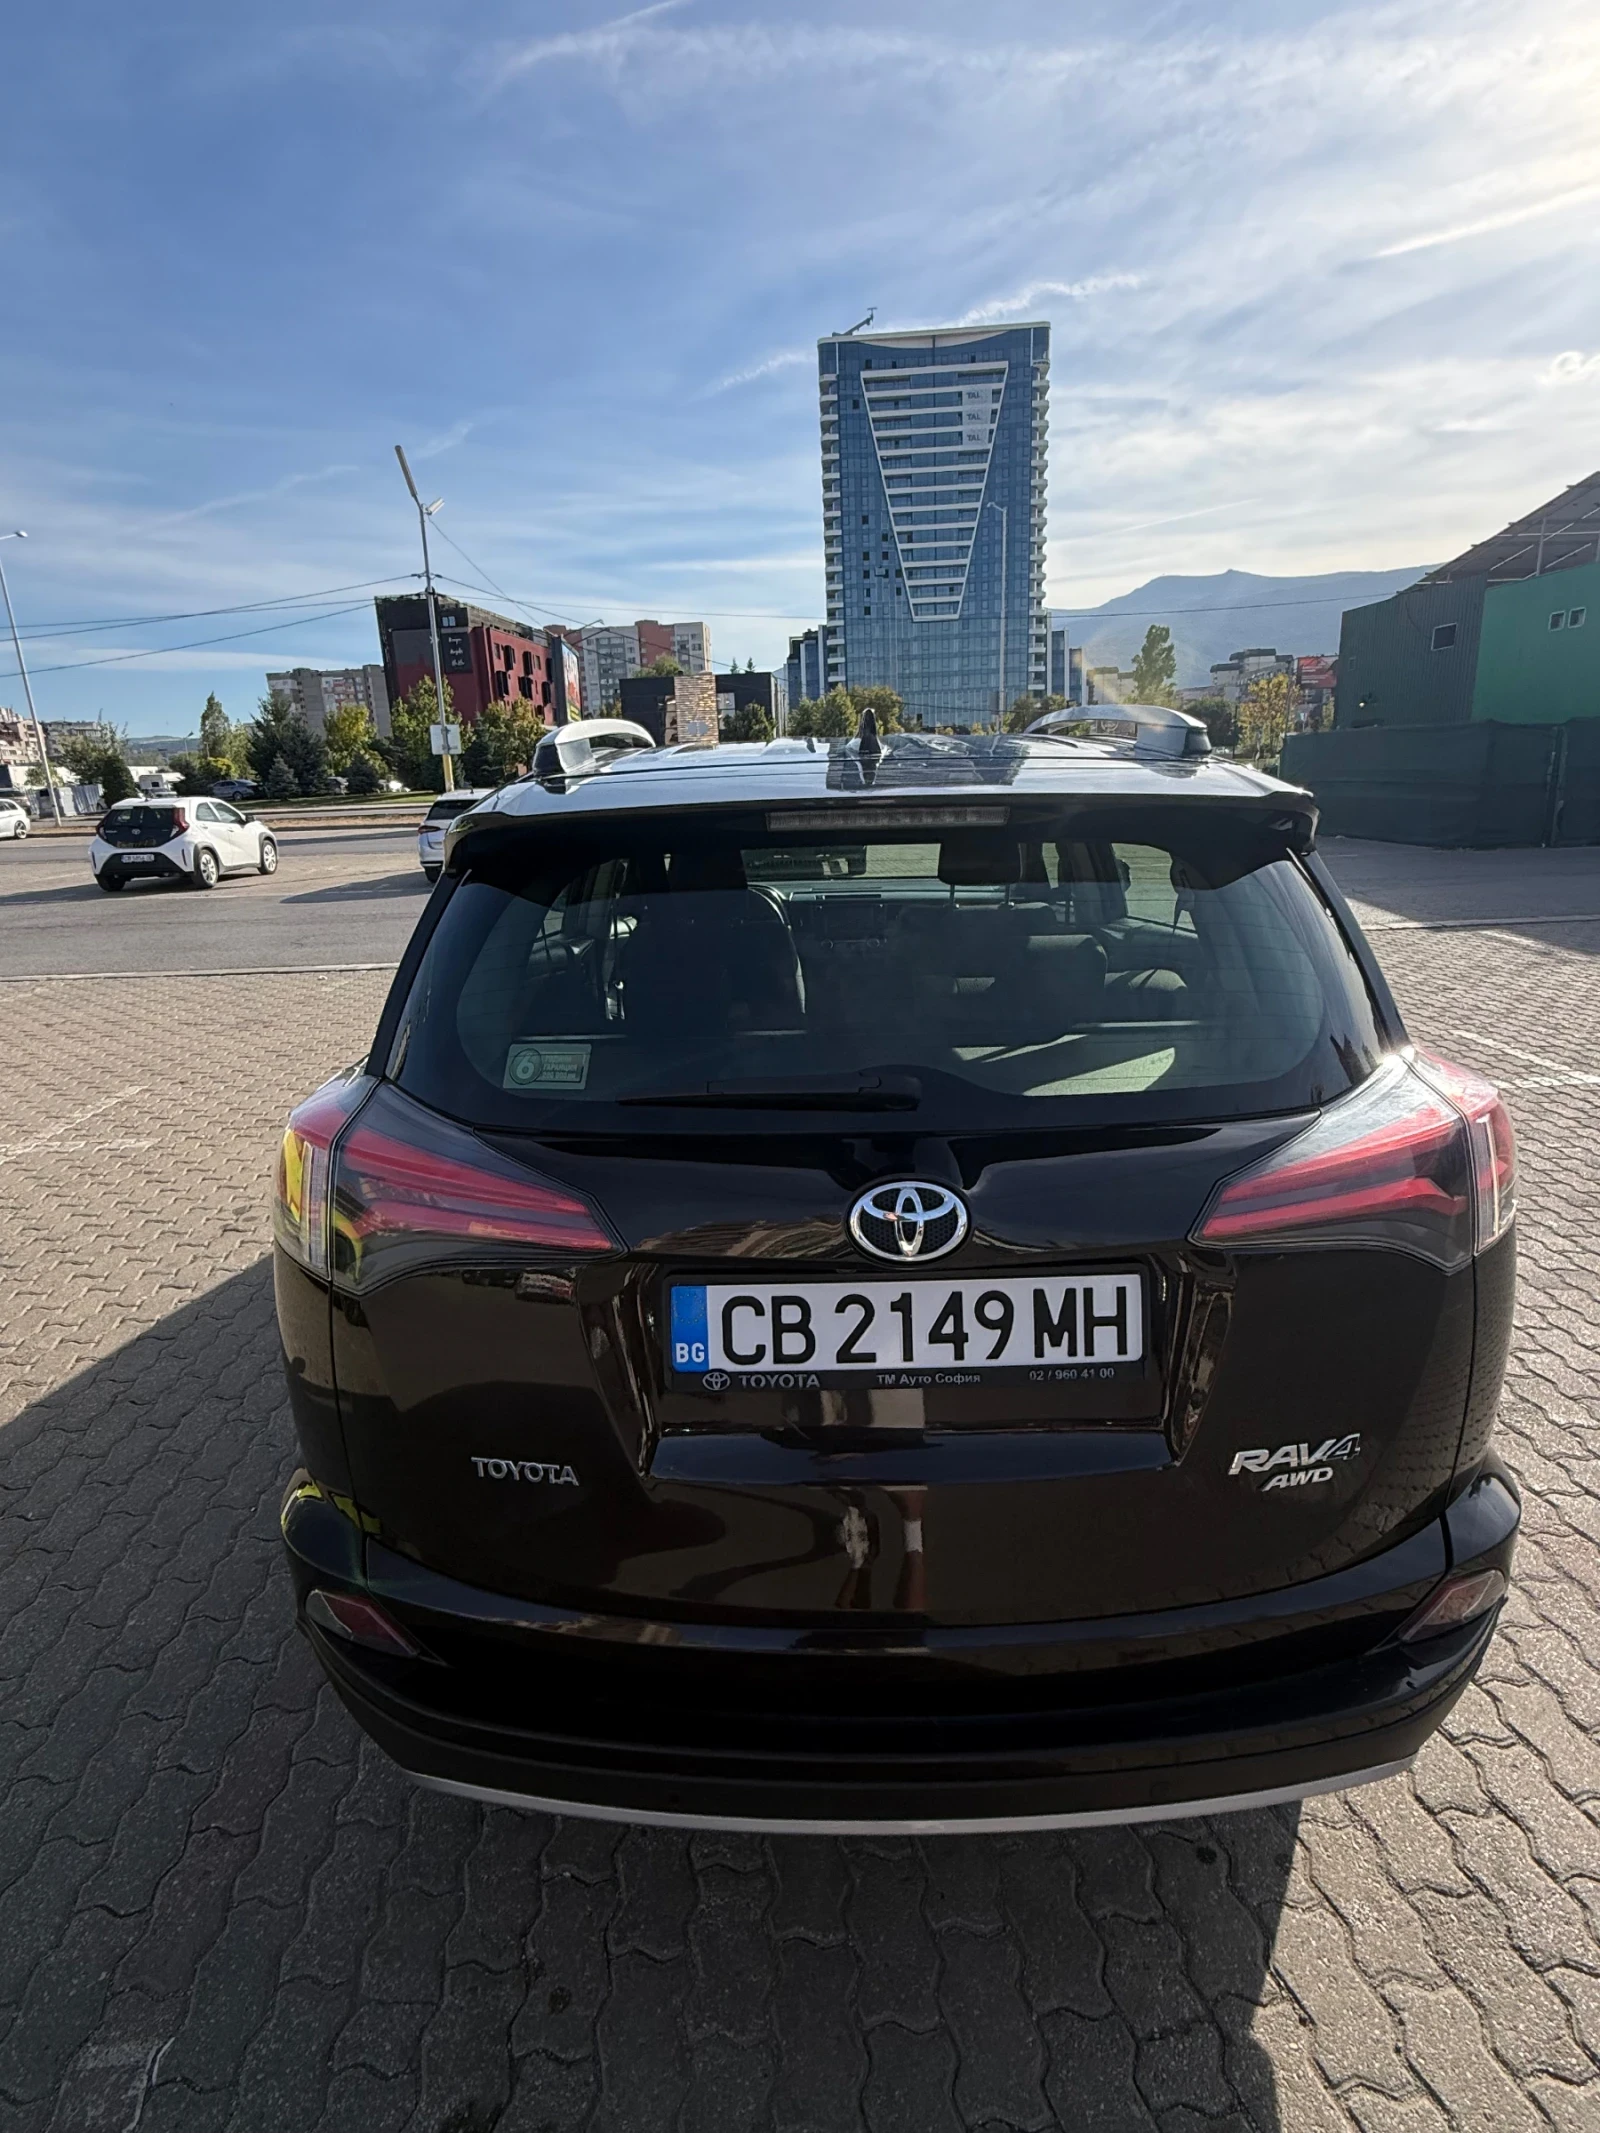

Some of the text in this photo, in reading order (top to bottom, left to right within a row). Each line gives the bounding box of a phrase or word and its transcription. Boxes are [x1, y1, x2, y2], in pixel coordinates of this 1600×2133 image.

[516, 1055, 535, 1080] 6
[721, 1286, 1128, 1366] CB 2149 MH
[675, 1342, 705, 1363] BG
[738, 1373, 821, 1389] TOYOTA
[899, 1373, 932, 1386] Ауто
[935, 1372, 981, 1386] София
[1029, 1369, 1044, 1381] 02
[1054, 1368, 1078, 1380] 960
[1080, 1367, 1095, 1379] 41
[1099, 1367, 1115, 1379] 00
[1228, 1432, 1361, 1476] RAV4
[470, 1456, 580, 1487] TOYOTA
[1261, 1466, 1334, 1492] AWD
